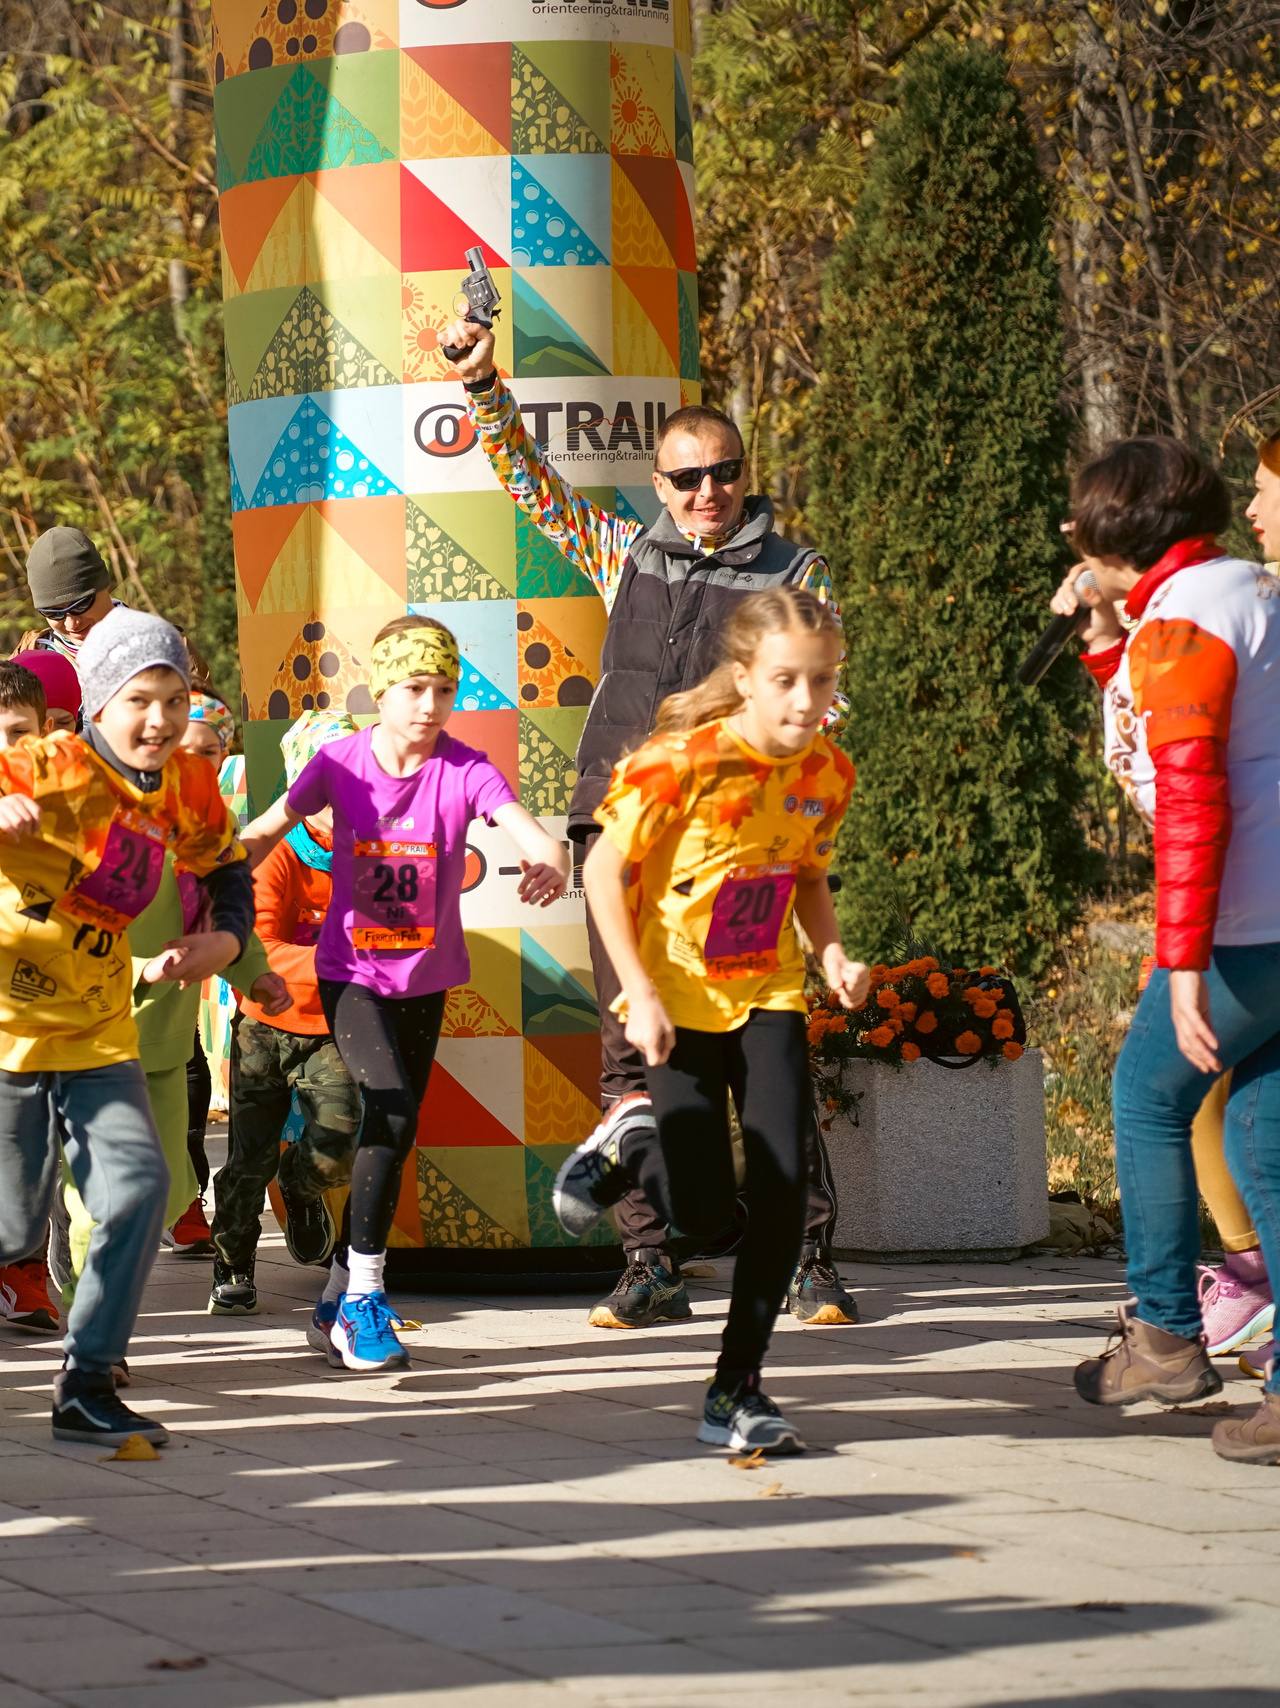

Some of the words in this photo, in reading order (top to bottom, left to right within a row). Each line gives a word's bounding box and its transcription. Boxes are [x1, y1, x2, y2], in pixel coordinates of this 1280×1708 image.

[532, 4, 669, 23] orienteering&trailrunning
[546, 450, 654, 463] rienteering&trailru
[110, 837, 152, 890] 24
[373, 863, 419, 903] 28
[387, 906, 405, 919] Ni
[728, 883, 777, 927] 20
